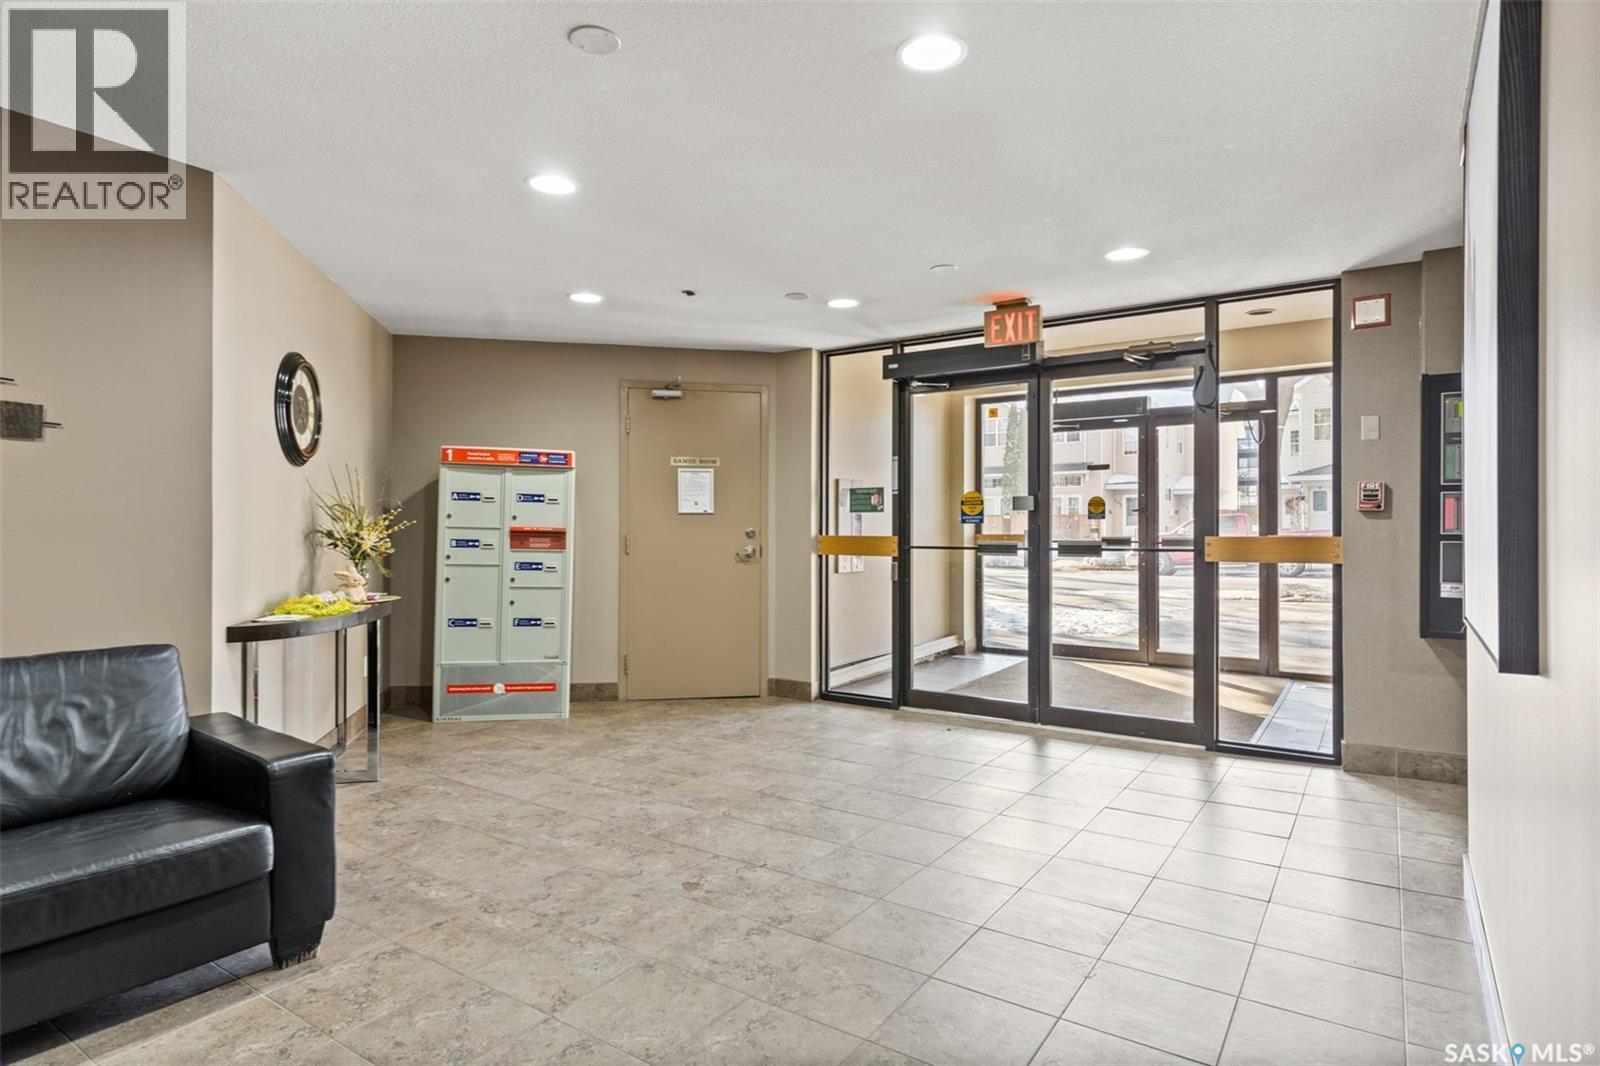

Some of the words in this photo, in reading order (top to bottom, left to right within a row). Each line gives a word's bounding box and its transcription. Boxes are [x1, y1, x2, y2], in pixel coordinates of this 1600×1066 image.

[989, 309, 1037, 344] EXIT
[445, 449, 453, 461] 1
[452, 492, 459, 500] A
[517, 494, 524, 502] D
[514, 618, 520, 626] F
